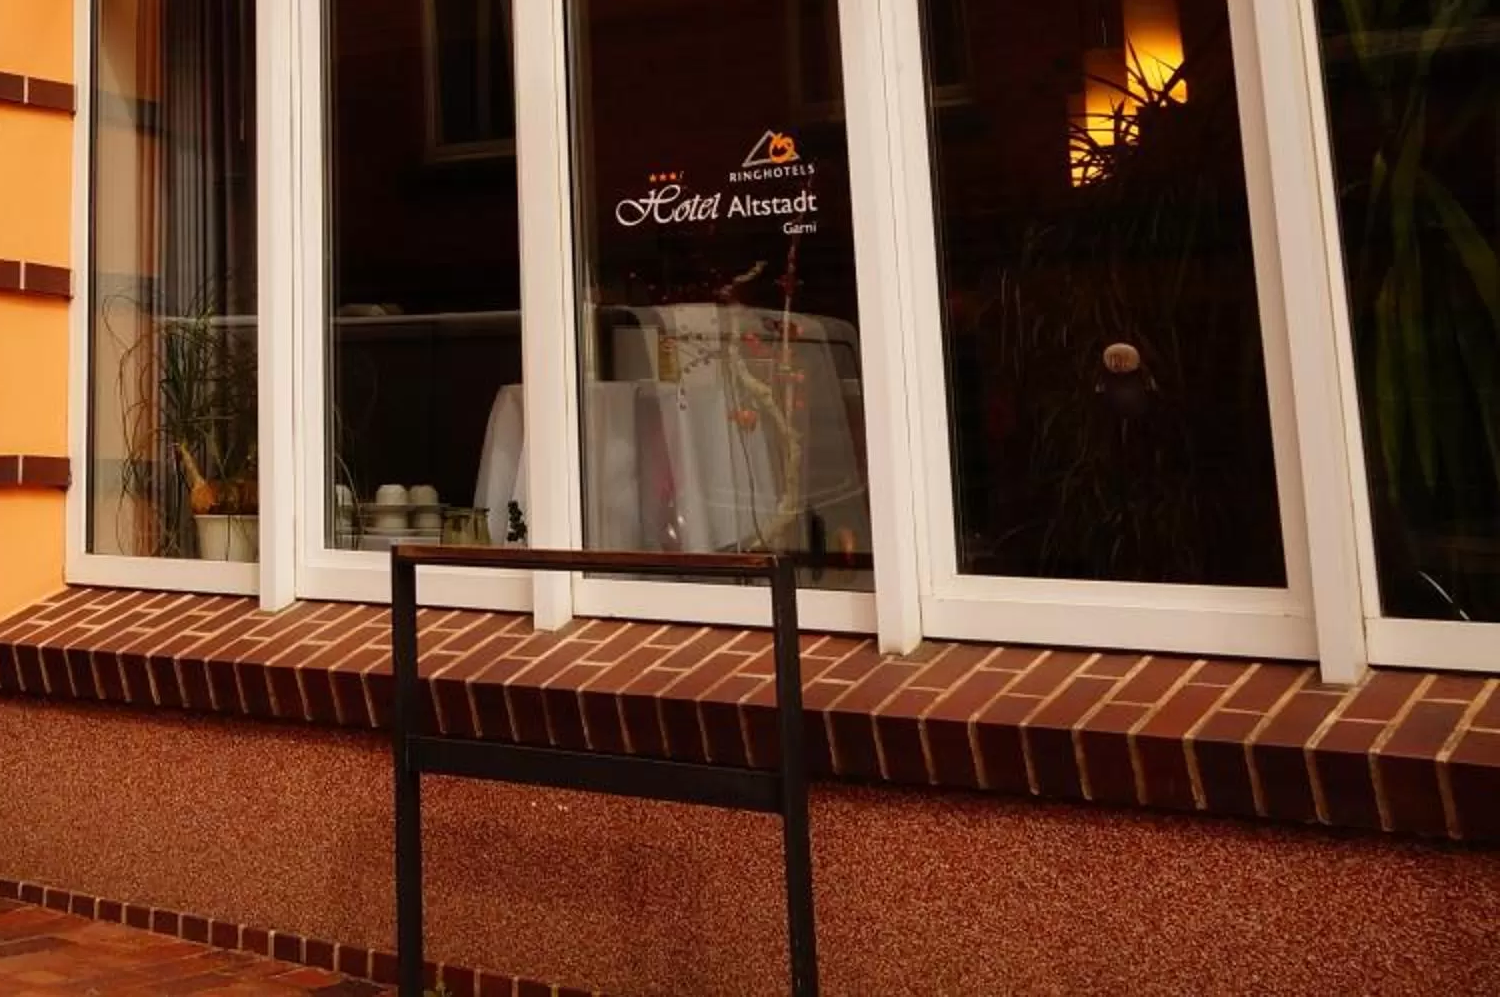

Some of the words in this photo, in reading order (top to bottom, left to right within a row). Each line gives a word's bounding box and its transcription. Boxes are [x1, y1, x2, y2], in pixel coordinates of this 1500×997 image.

[728, 164, 815, 183] RINGHOTELS
[615, 184, 722, 226] Hotel
[727, 190, 818, 218] Altstadt
[783, 221, 817, 235] Garni
